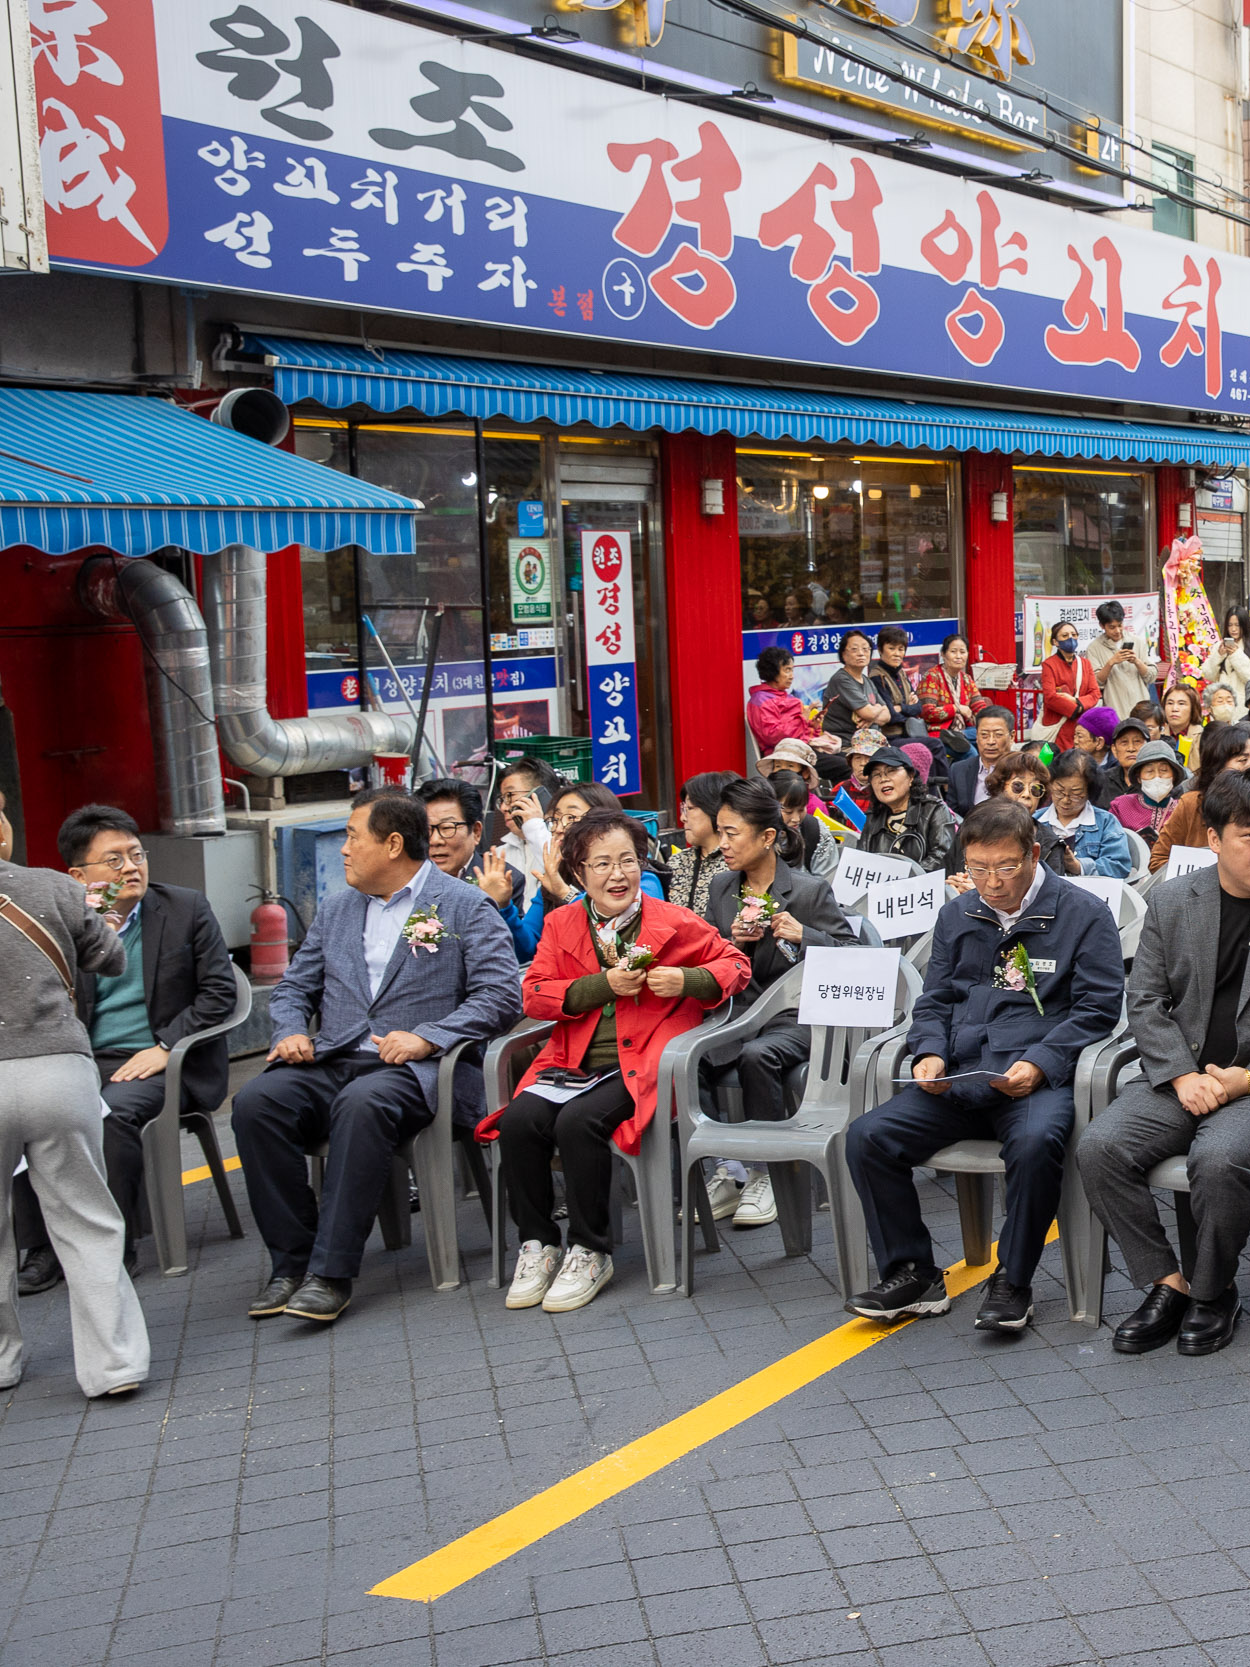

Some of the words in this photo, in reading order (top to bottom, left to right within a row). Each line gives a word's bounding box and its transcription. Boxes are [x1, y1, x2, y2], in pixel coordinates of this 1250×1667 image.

[197, 136, 529, 248] 양꼬치거리
[204, 210, 537, 308] 선두주자
[606, 120, 1223, 399] 경성양꼬치
[593, 545, 621, 569] 원조
[878, 888, 934, 919] 내빈석
[818, 983, 886, 1002] 당협위원장님
